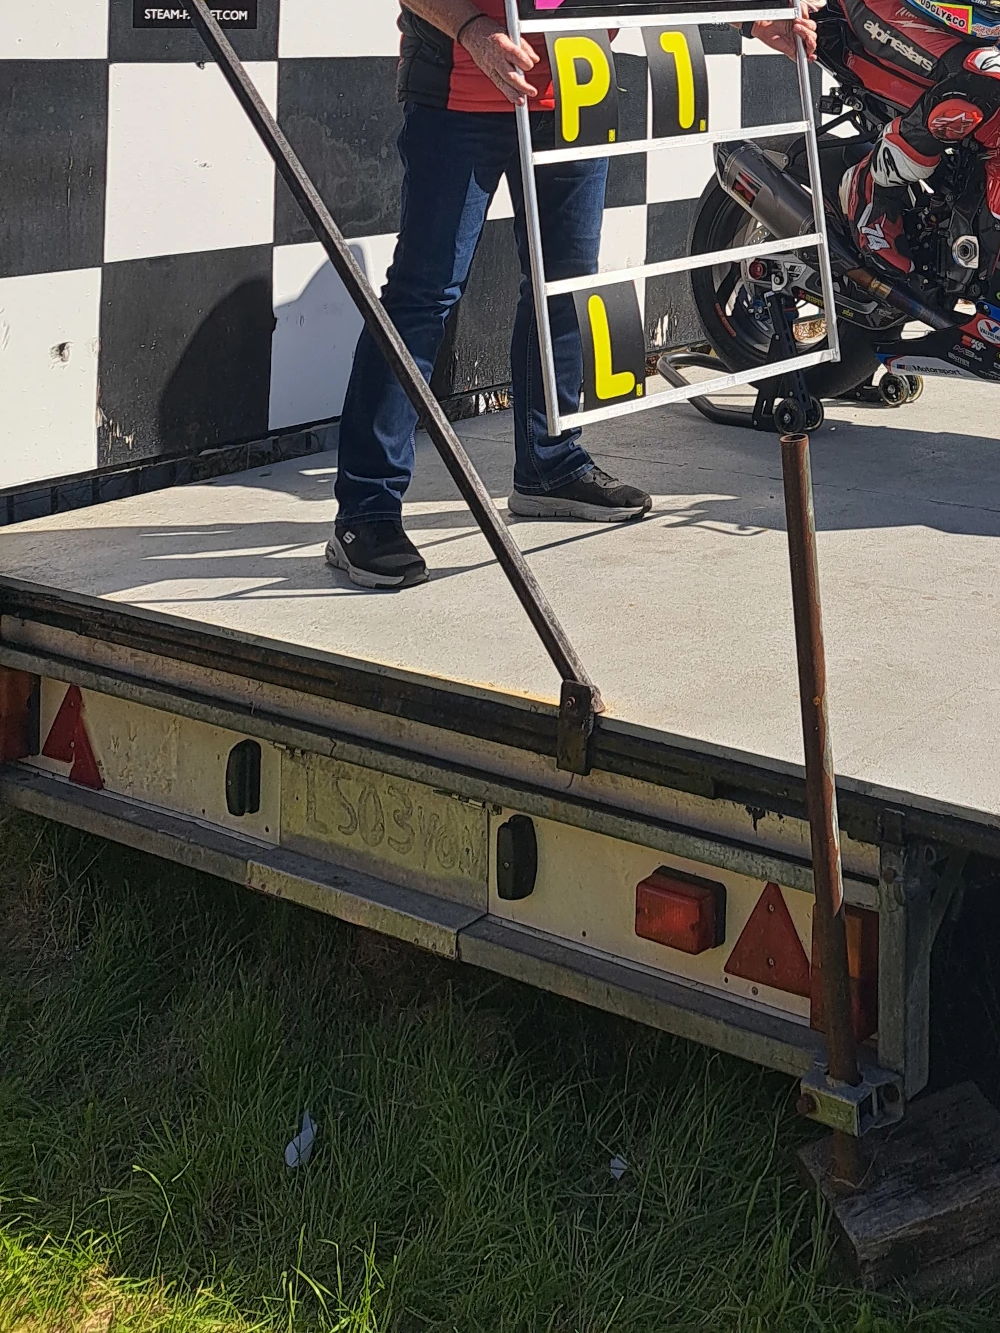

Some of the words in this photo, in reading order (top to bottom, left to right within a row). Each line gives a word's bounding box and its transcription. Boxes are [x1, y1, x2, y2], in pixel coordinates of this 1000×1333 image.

[863, 19, 934, 72] alpinestars
[554, 36, 611, 142] P
[660, 31, 695, 129] 1
[588, 294, 635, 400] L
[912, 365, 963, 375] Motorsport
